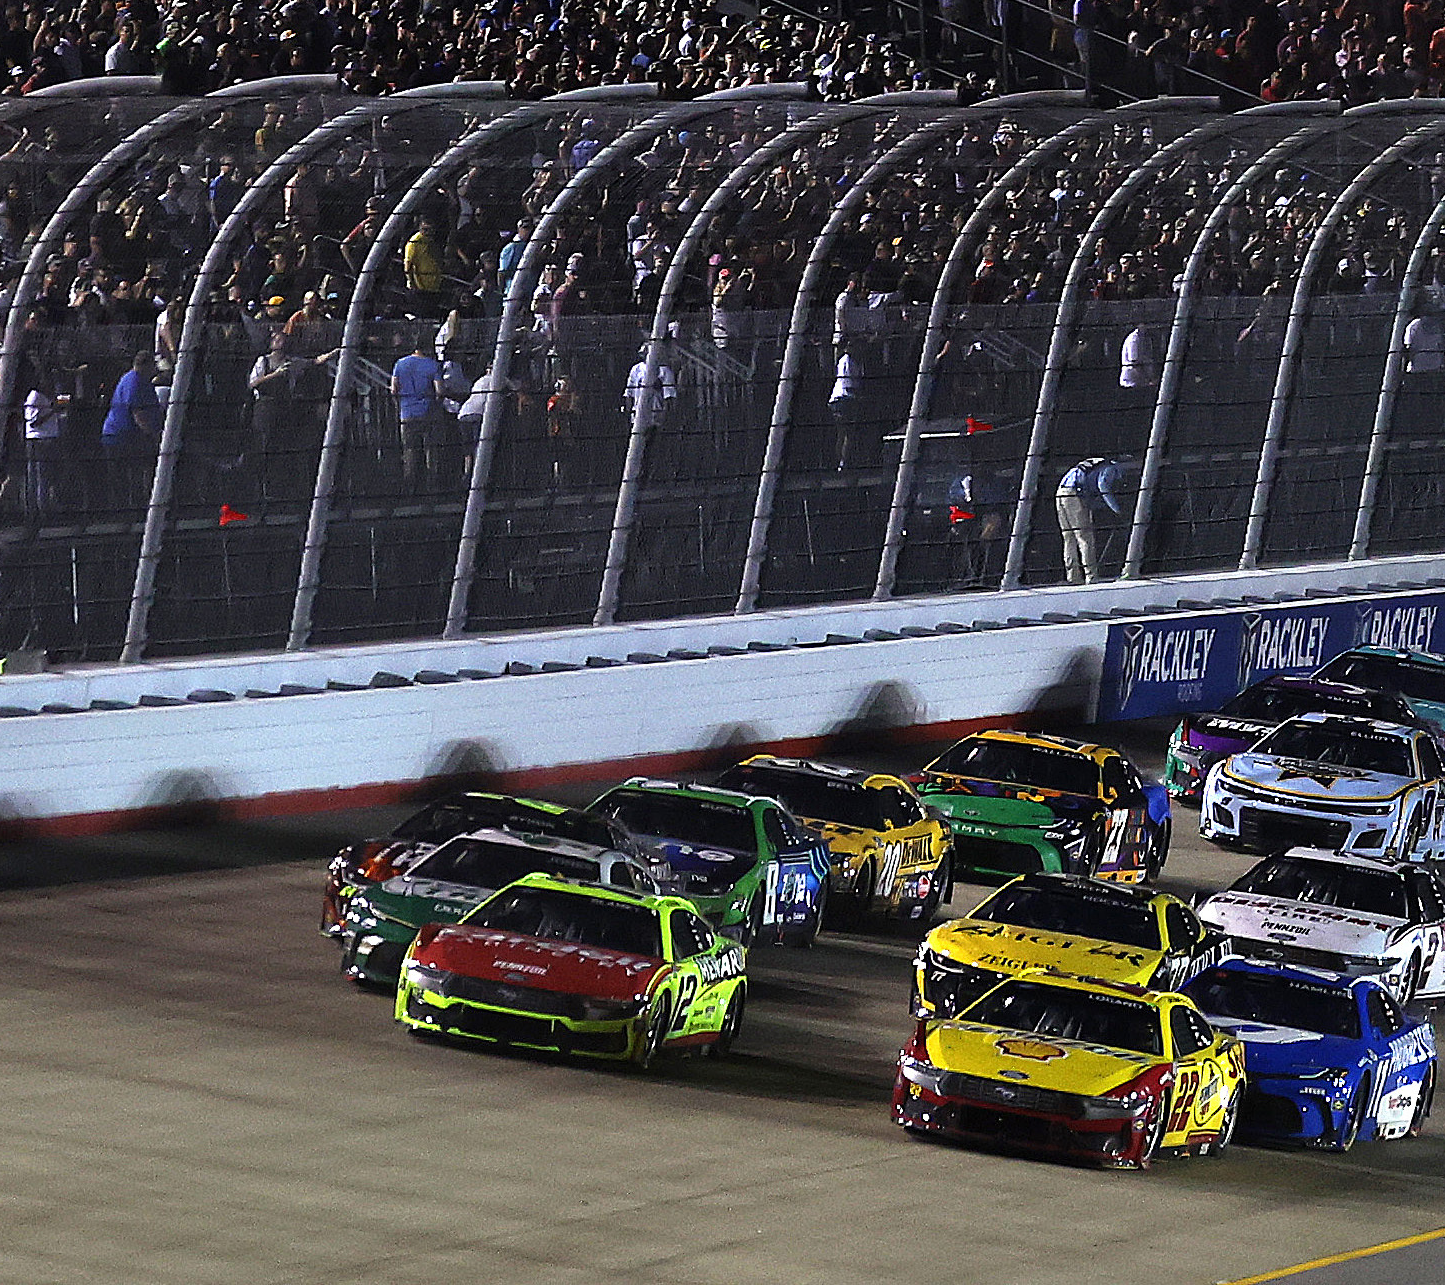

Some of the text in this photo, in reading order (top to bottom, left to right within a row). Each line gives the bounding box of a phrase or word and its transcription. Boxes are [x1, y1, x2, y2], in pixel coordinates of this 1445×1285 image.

[1138, 629, 1216, 682] RACKLEY
[1256, 617, 1331, 670] RACKLEY
[1370, 605, 1438, 653] RACKLEY
[1166, 1072, 1200, 1132] 22
